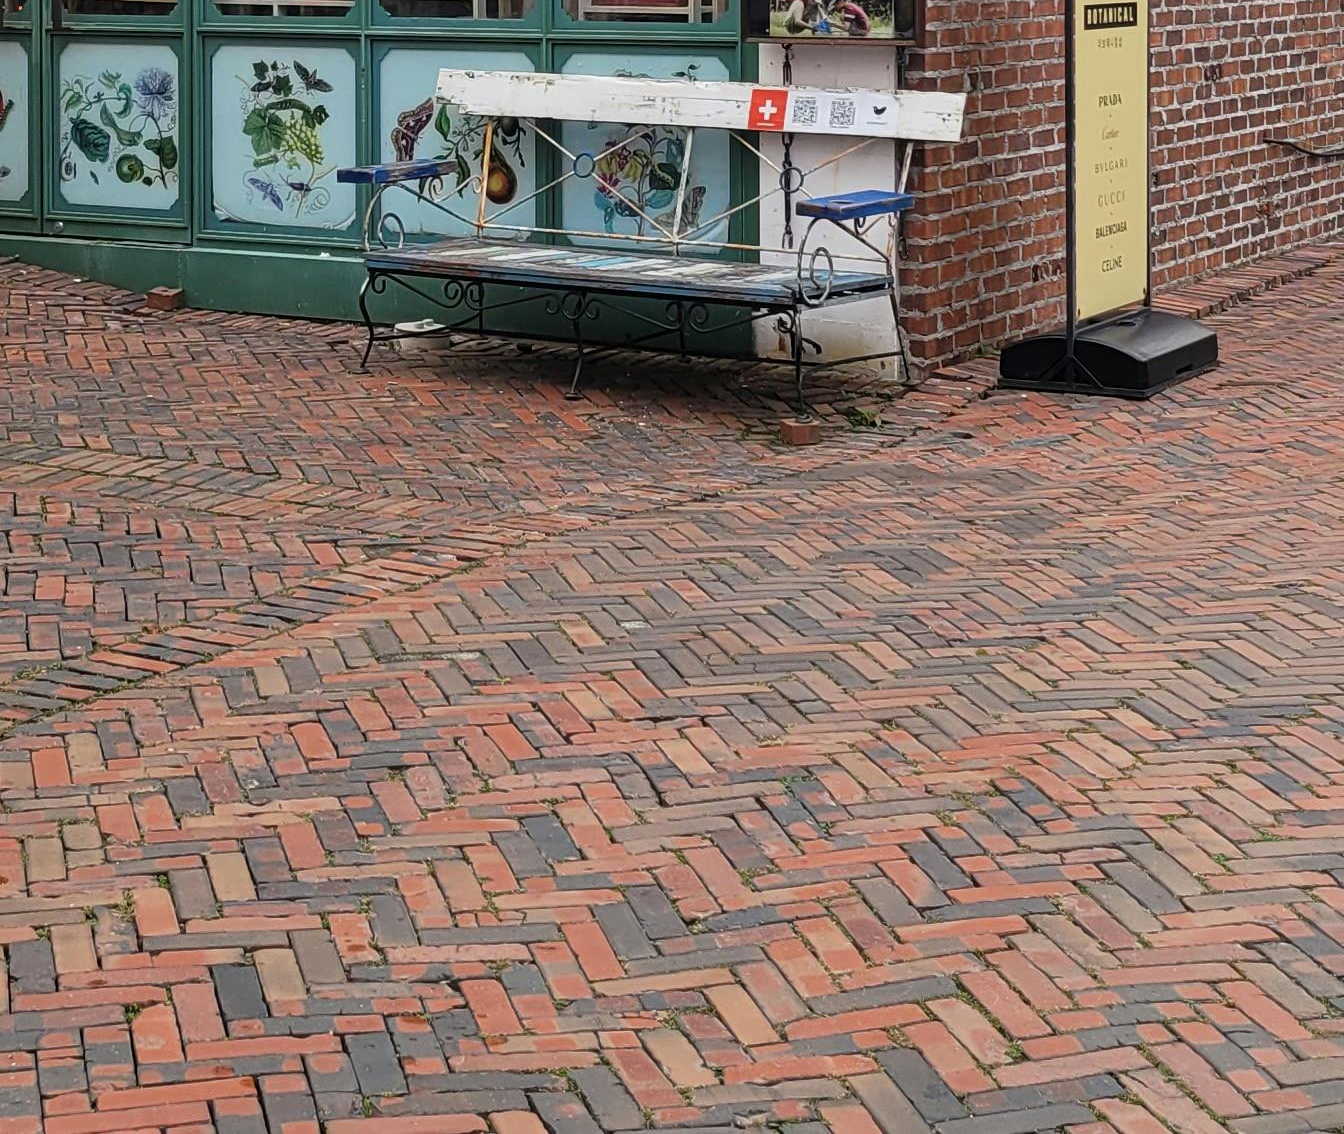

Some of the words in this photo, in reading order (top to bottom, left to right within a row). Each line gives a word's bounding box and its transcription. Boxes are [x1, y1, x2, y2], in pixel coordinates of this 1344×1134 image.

[1087, 6, 1134, 25] BOTANICAL
[1098, 93, 1123, 108] PRADA
[1094, 158, 1128, 174] BVLGARI
[1097, 190, 1126, 208] GUCCI
[1095, 220, 1128, 240] BALENCIAGA
[1101, 255, 1123, 274] CELINE
